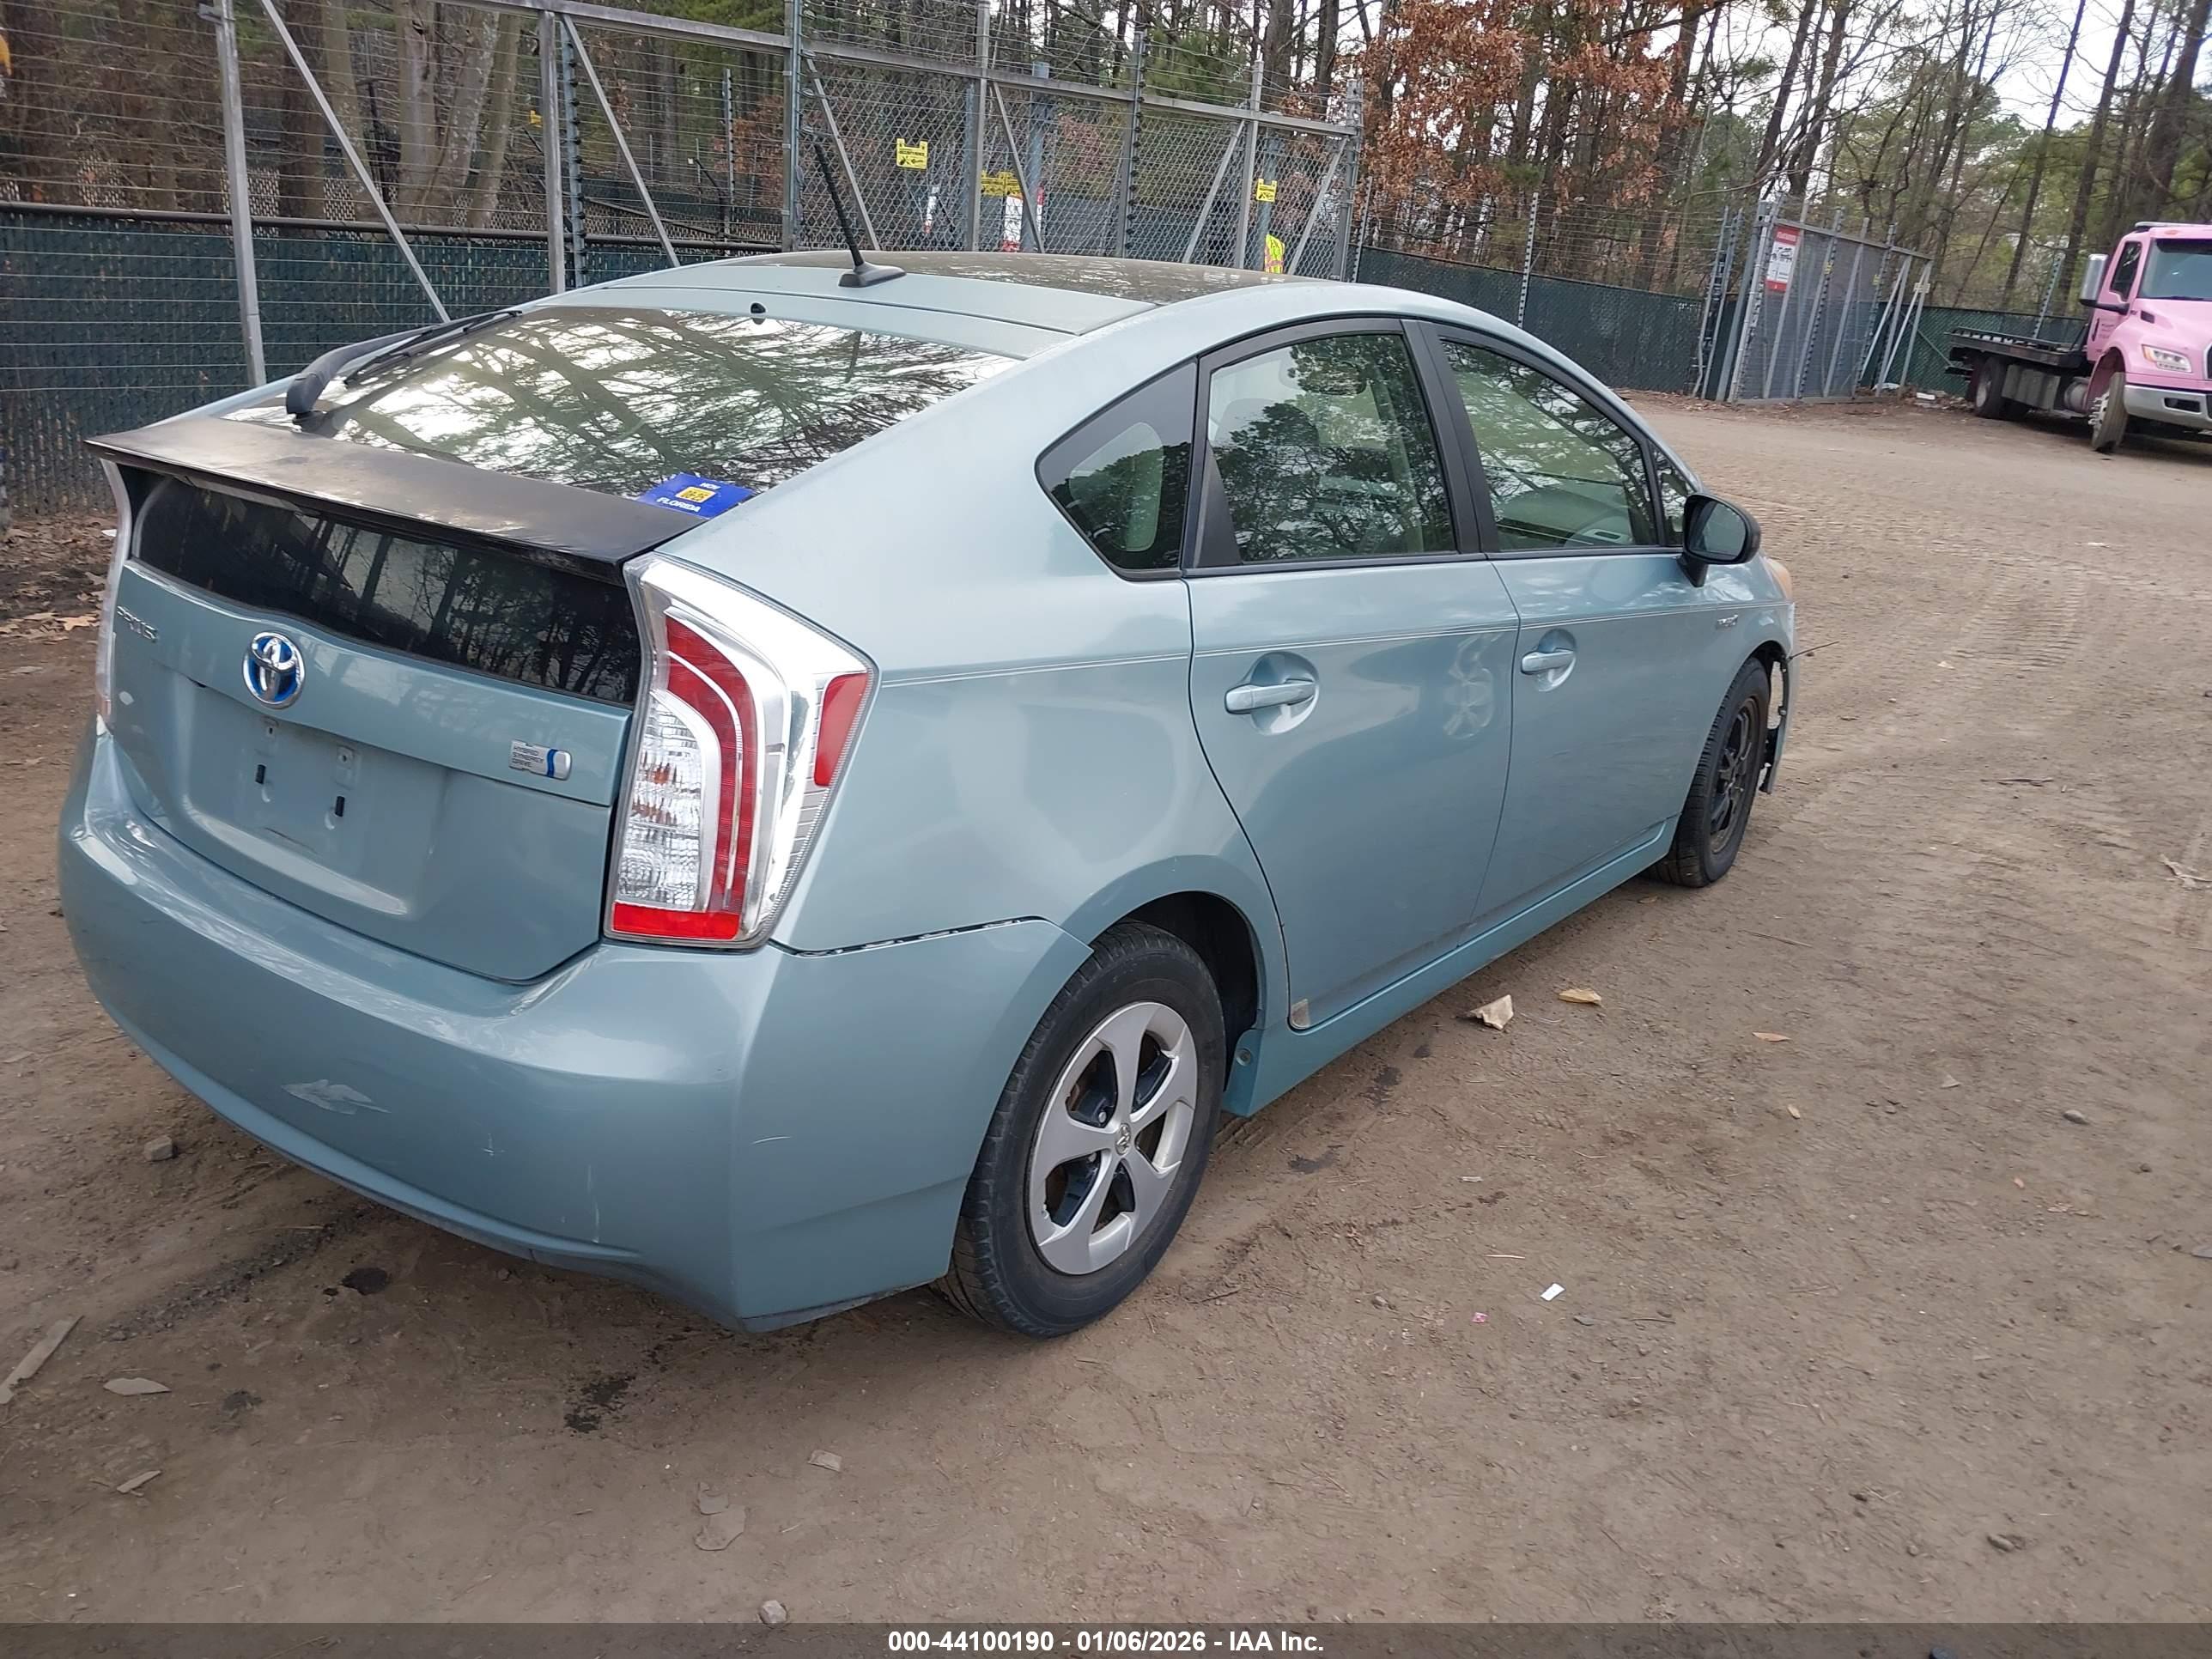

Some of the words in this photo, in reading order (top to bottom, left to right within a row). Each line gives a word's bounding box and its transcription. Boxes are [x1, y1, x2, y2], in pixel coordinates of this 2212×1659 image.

[656, 497, 702, 513] FLORIDA
[514, 746, 539, 756] HYBRID
[513, 752, 544, 763] SYNERGY
[512, 758, 532, 768] DRIVE
